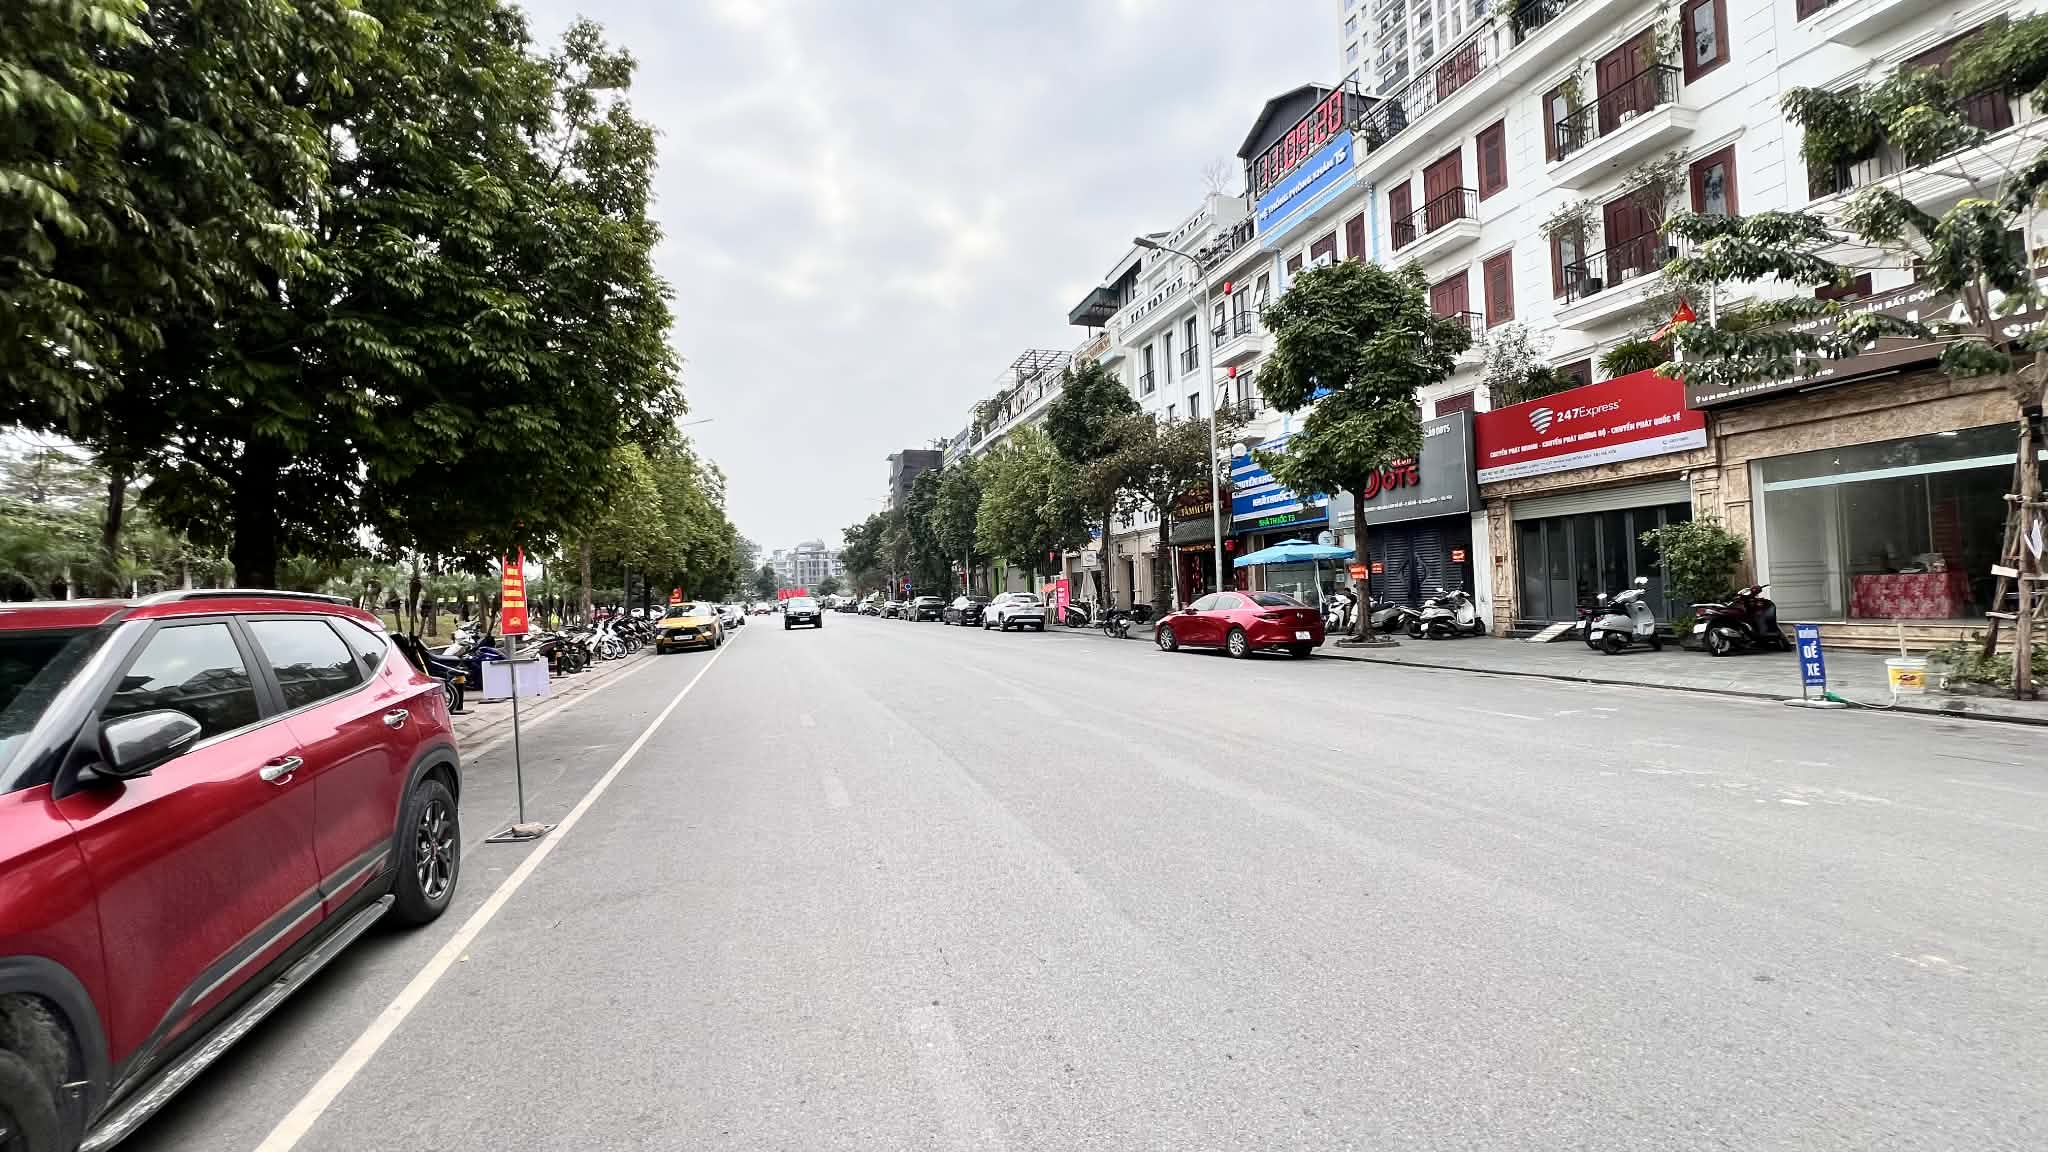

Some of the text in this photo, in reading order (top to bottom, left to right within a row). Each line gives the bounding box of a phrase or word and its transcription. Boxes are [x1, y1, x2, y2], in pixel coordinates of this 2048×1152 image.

[1820, 317, 1832, 327] TY
[1885, 295, 1906, 309] BẤT
[1557, 401, 1620, 422] 247Express
[1806, 663, 1821, 676] XE
